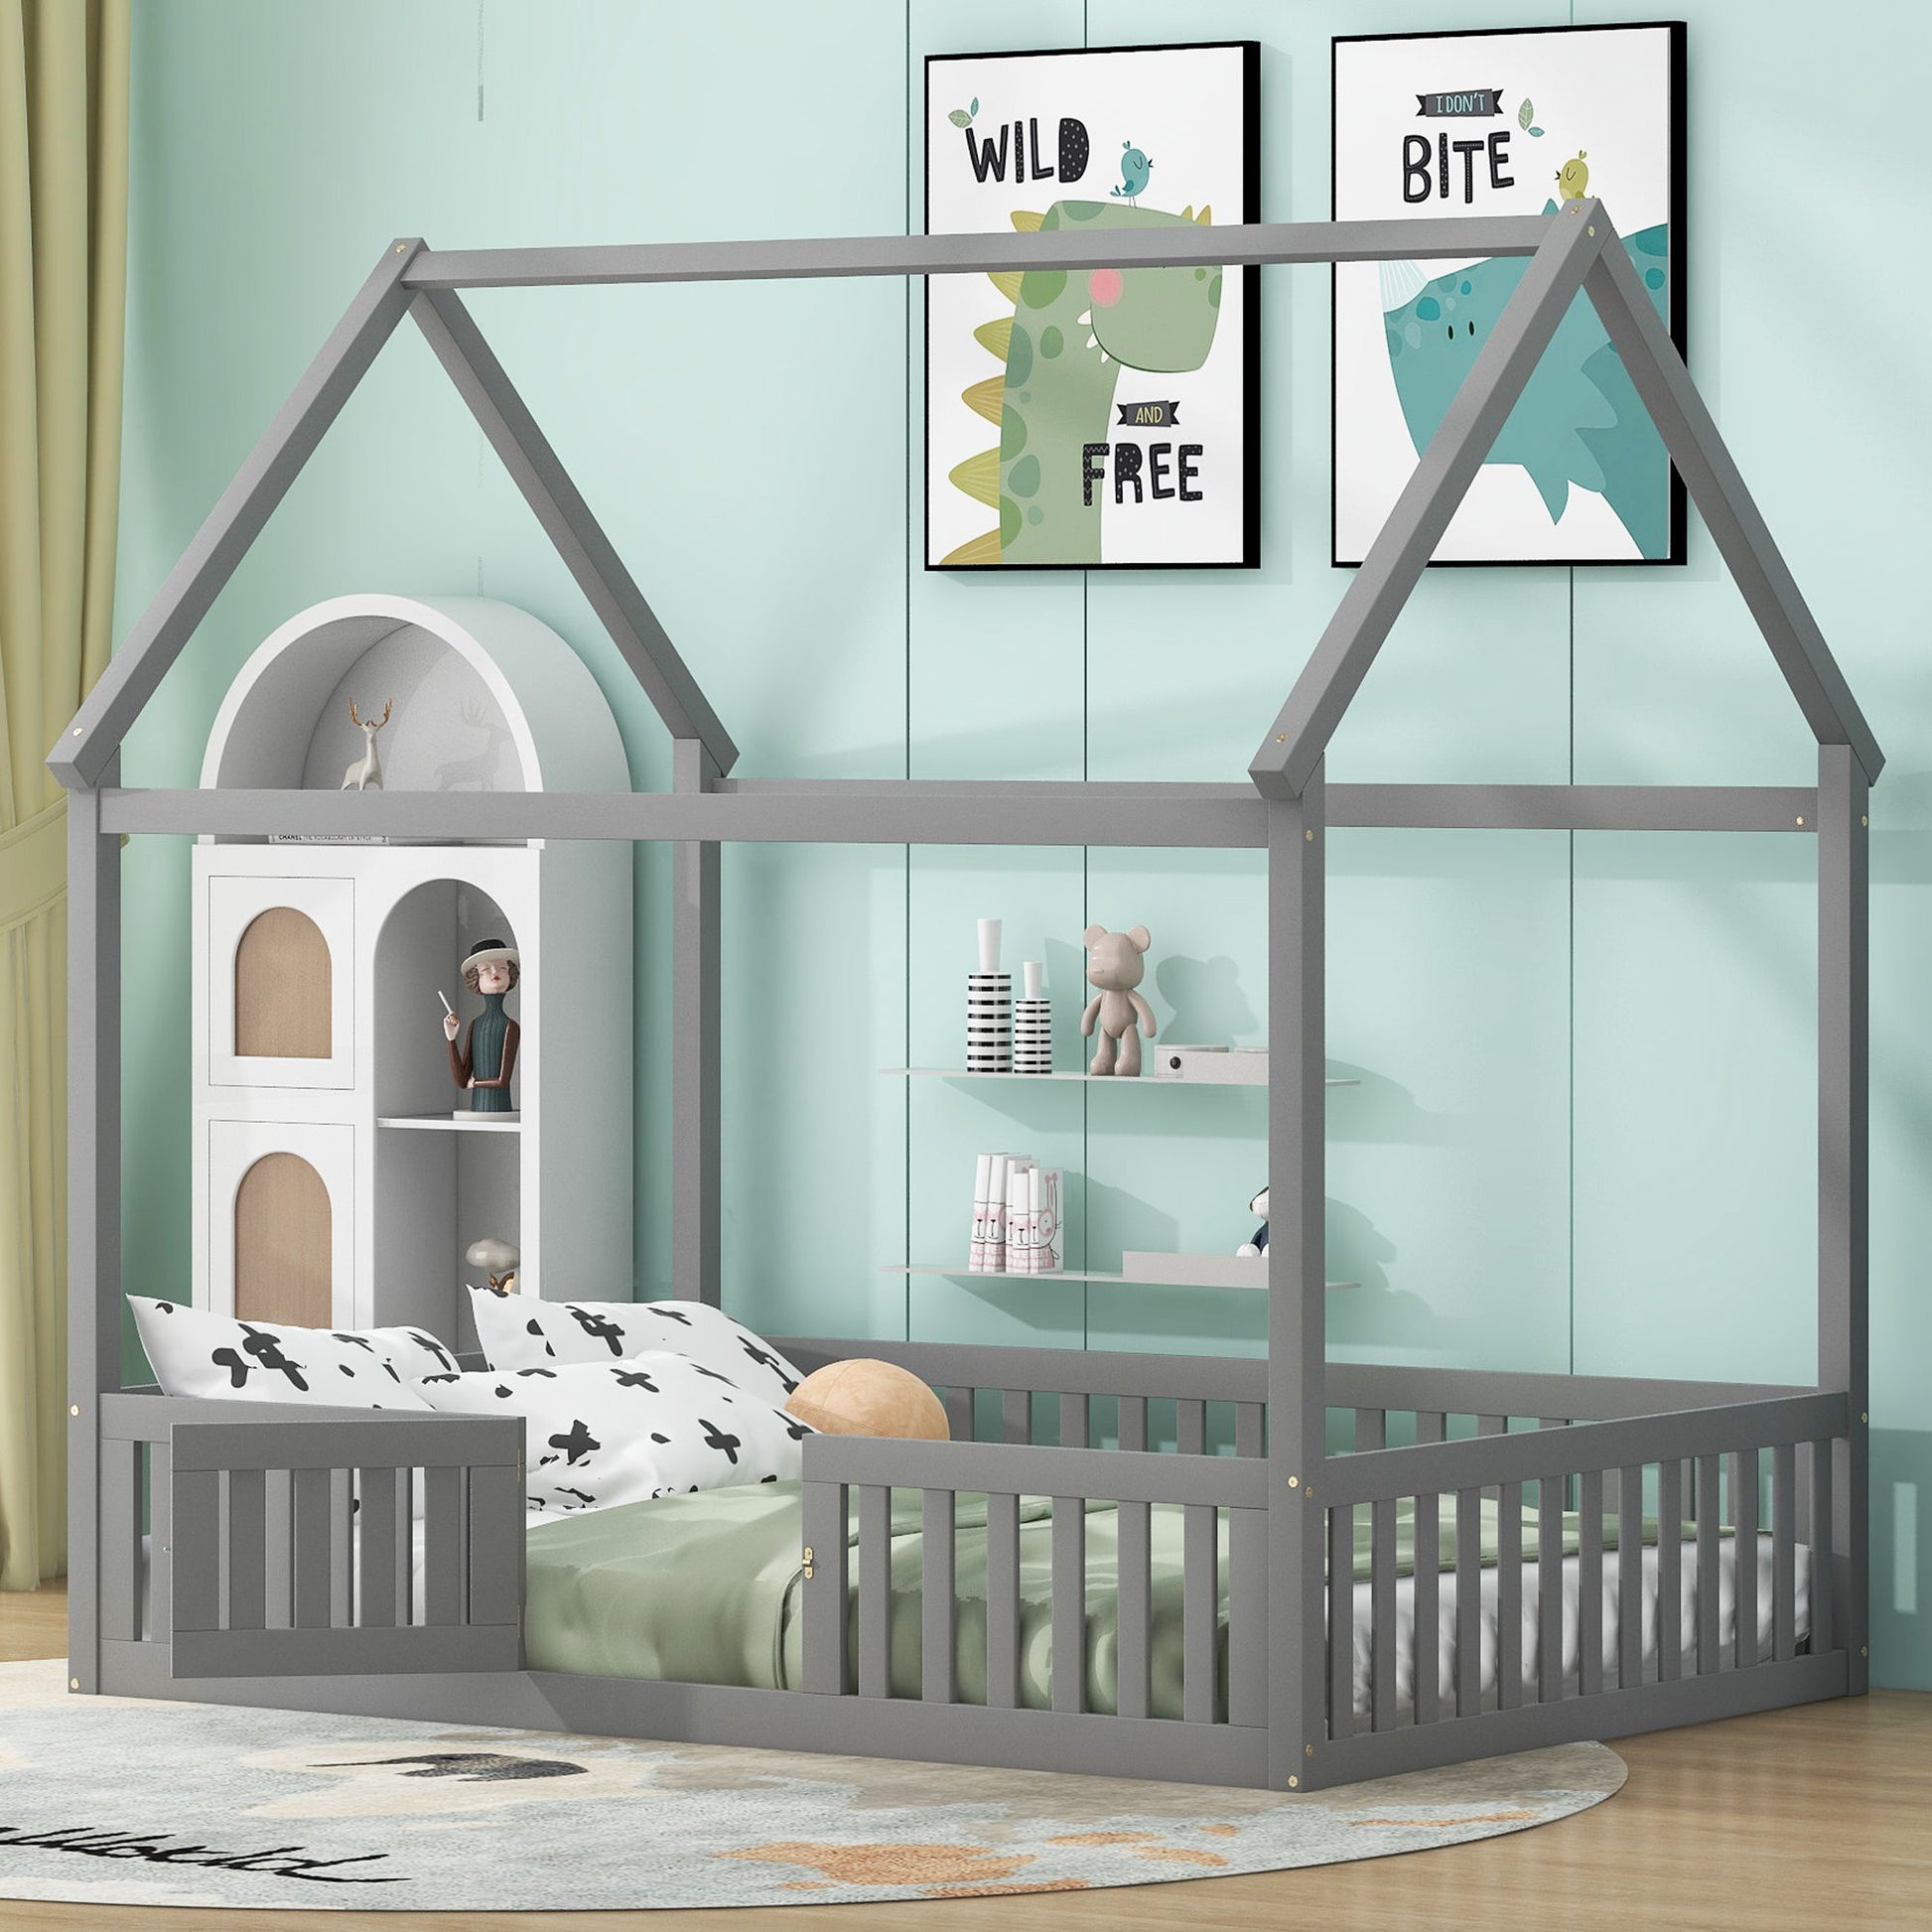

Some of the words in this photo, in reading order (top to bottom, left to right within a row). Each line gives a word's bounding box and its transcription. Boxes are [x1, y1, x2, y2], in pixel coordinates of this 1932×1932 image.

[1436, 95, 1443, 113] I
[1446, 91, 1485, 113] DON'T
[965, 117, 1090, 184] WILD
[1403, 131, 1515, 205] BITE
[1135, 405, 1164, 424] AND
[1083, 443, 1203, 506] FREE
